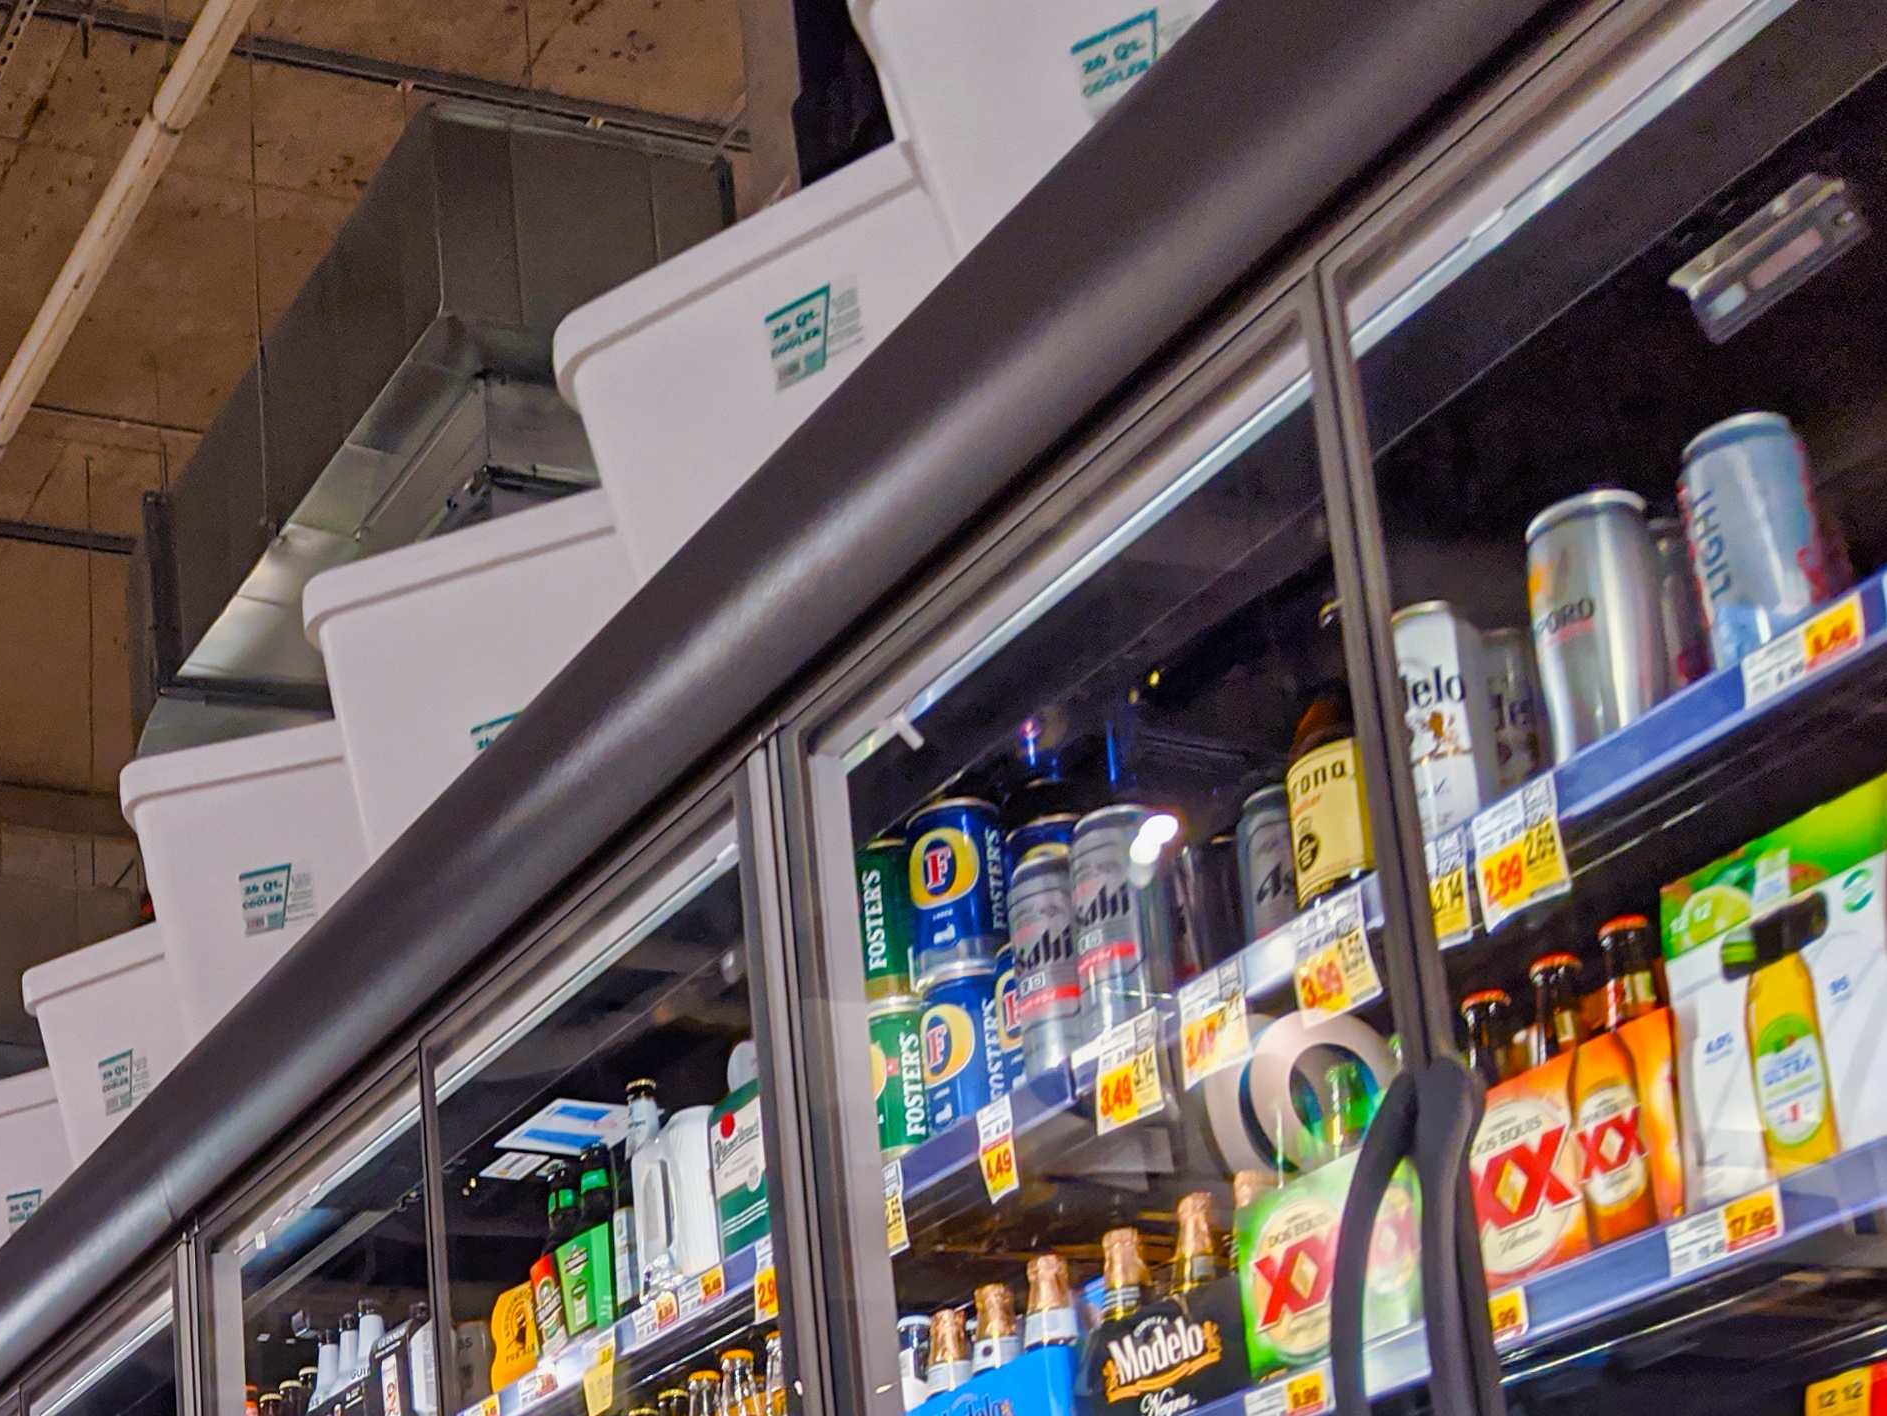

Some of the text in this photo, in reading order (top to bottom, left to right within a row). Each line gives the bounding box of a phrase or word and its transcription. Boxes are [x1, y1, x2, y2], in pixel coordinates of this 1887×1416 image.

[1692, 490, 1732, 601] LIGHT
[1484, 852, 1524, 899] 2.99
[1100, 1074, 1133, 1117] 3.49
[1108, 1317, 1204, 1386] Modelo
[1817, 1380, 1865, 1408] 12 12
